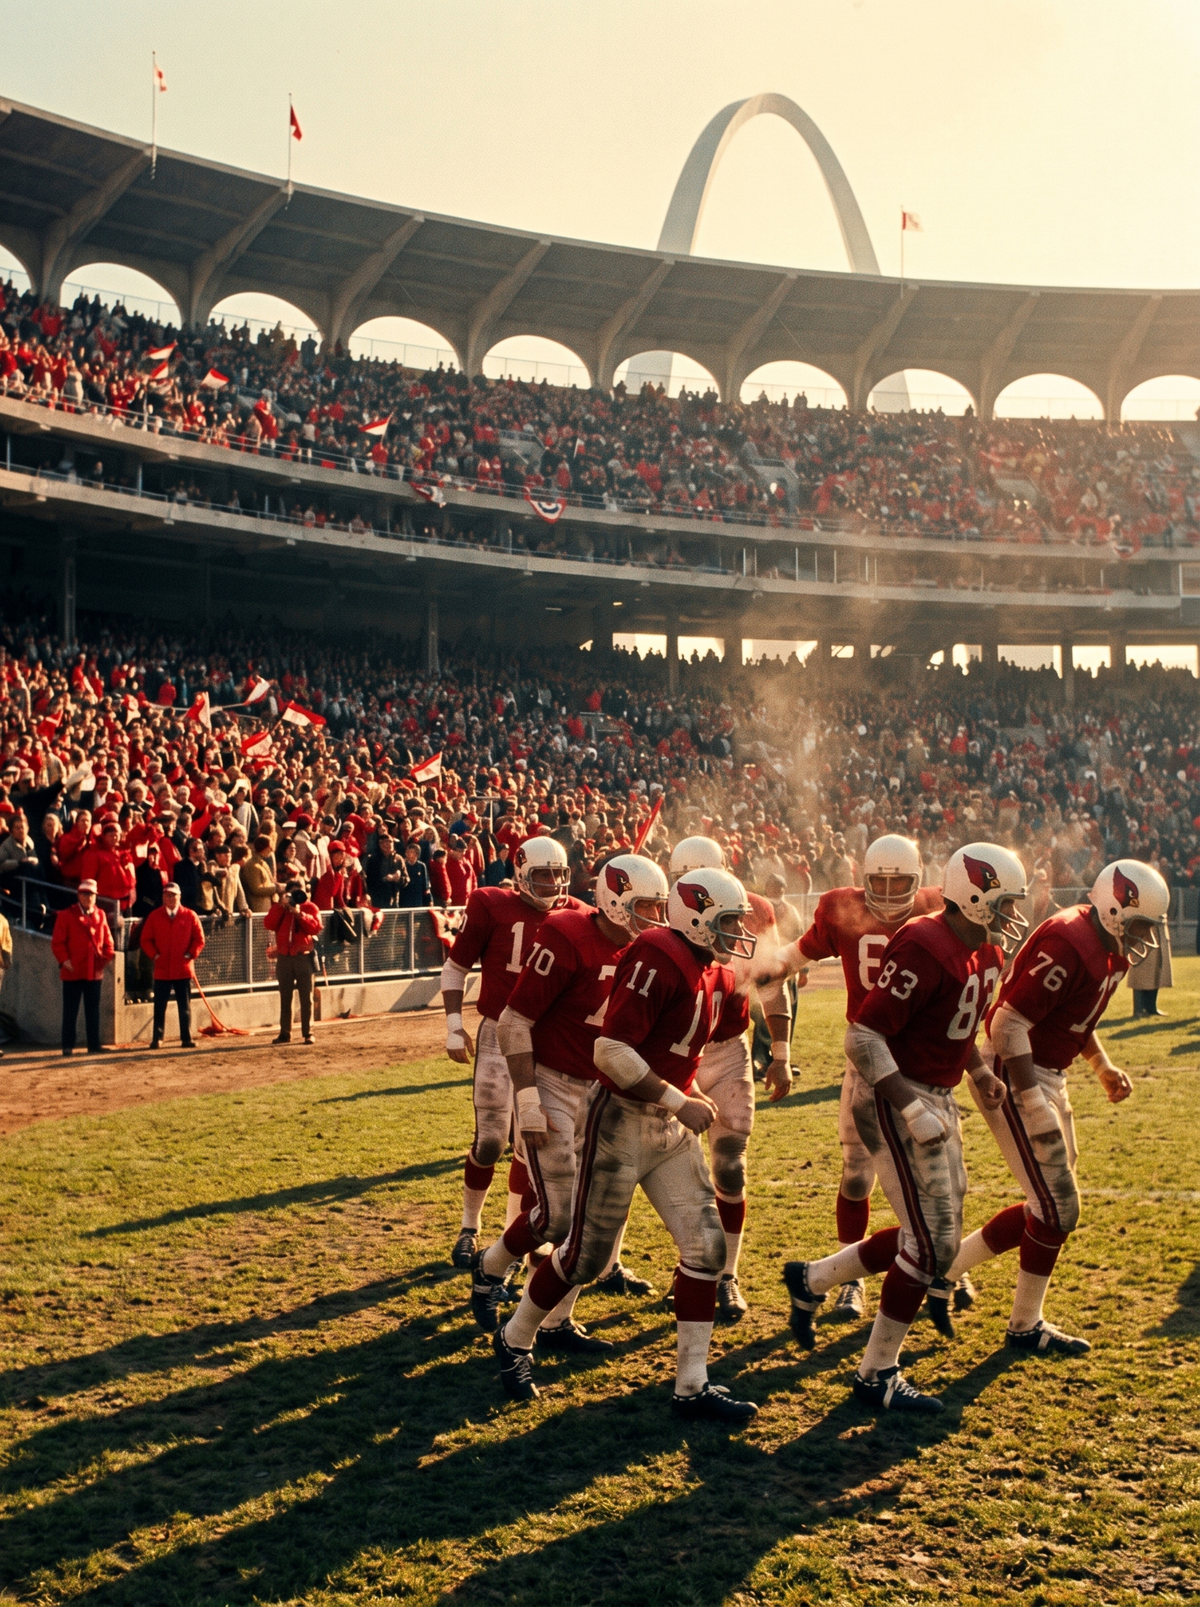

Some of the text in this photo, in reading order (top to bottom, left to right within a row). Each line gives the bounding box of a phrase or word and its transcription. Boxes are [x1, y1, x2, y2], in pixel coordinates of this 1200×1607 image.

[506, 921, 540, 973] 1
[626, 961, 657, 998] 11
[877, 960, 919, 1000] 83
[1028, 951, 1067, 992] 76
